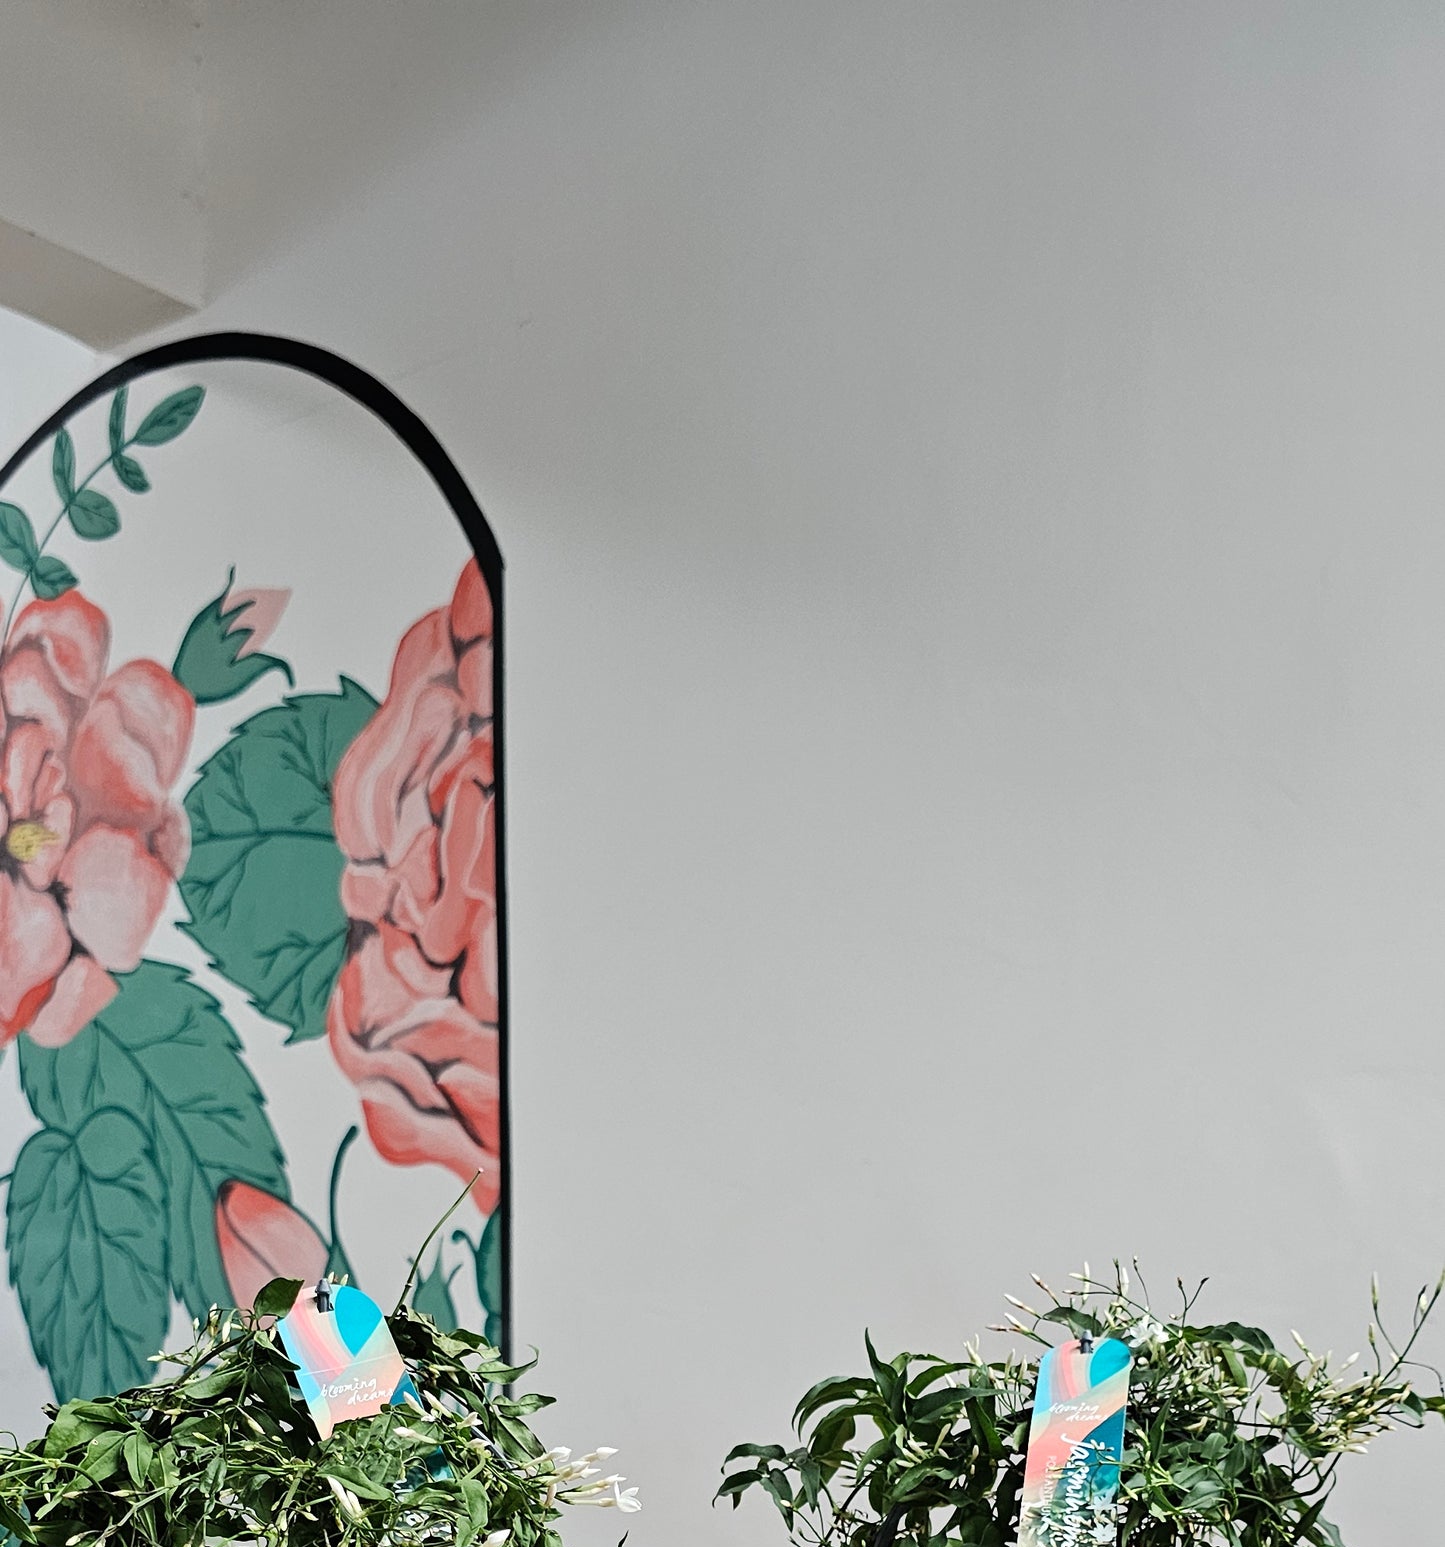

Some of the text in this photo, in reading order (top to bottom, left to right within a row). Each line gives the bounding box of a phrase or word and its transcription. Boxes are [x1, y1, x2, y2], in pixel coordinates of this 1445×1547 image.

[320, 1378, 377, 1398] blooming
[346, 1390, 394, 1405] dreams
[1048, 1402, 1100, 1415] blooming
